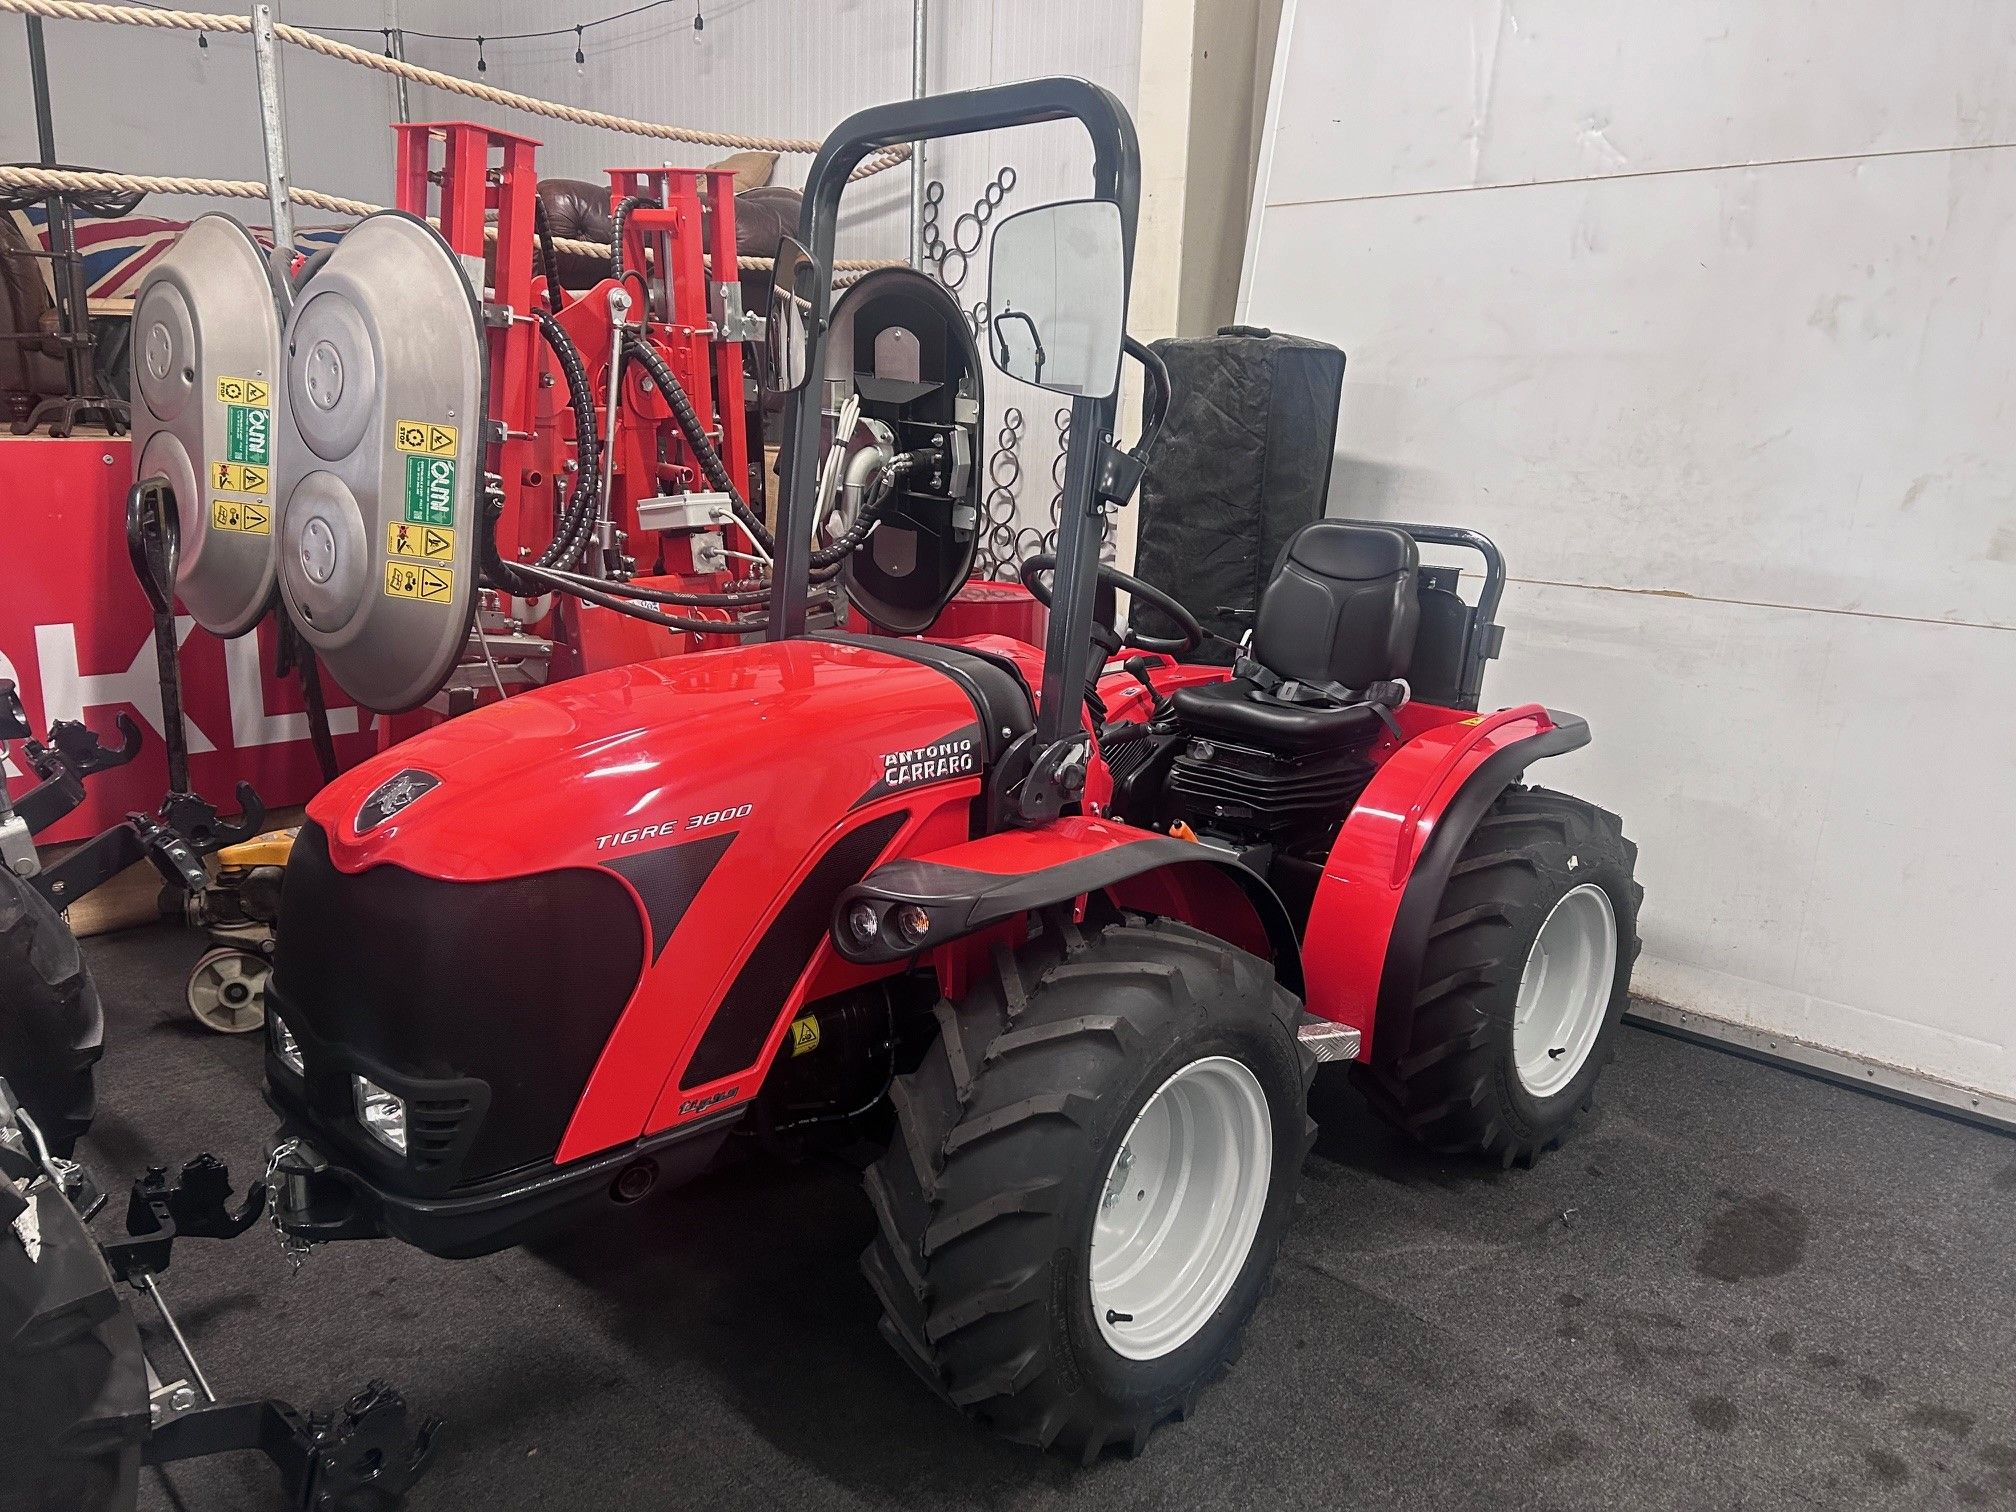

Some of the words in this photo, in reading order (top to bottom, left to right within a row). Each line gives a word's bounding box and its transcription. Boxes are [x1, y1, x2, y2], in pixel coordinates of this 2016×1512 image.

[884, 739, 971, 767] ANTONIO
[885, 753, 972, 787] CARRARO
[595, 820, 678, 850] TIGRE
[684, 803, 753, 831] 3800
